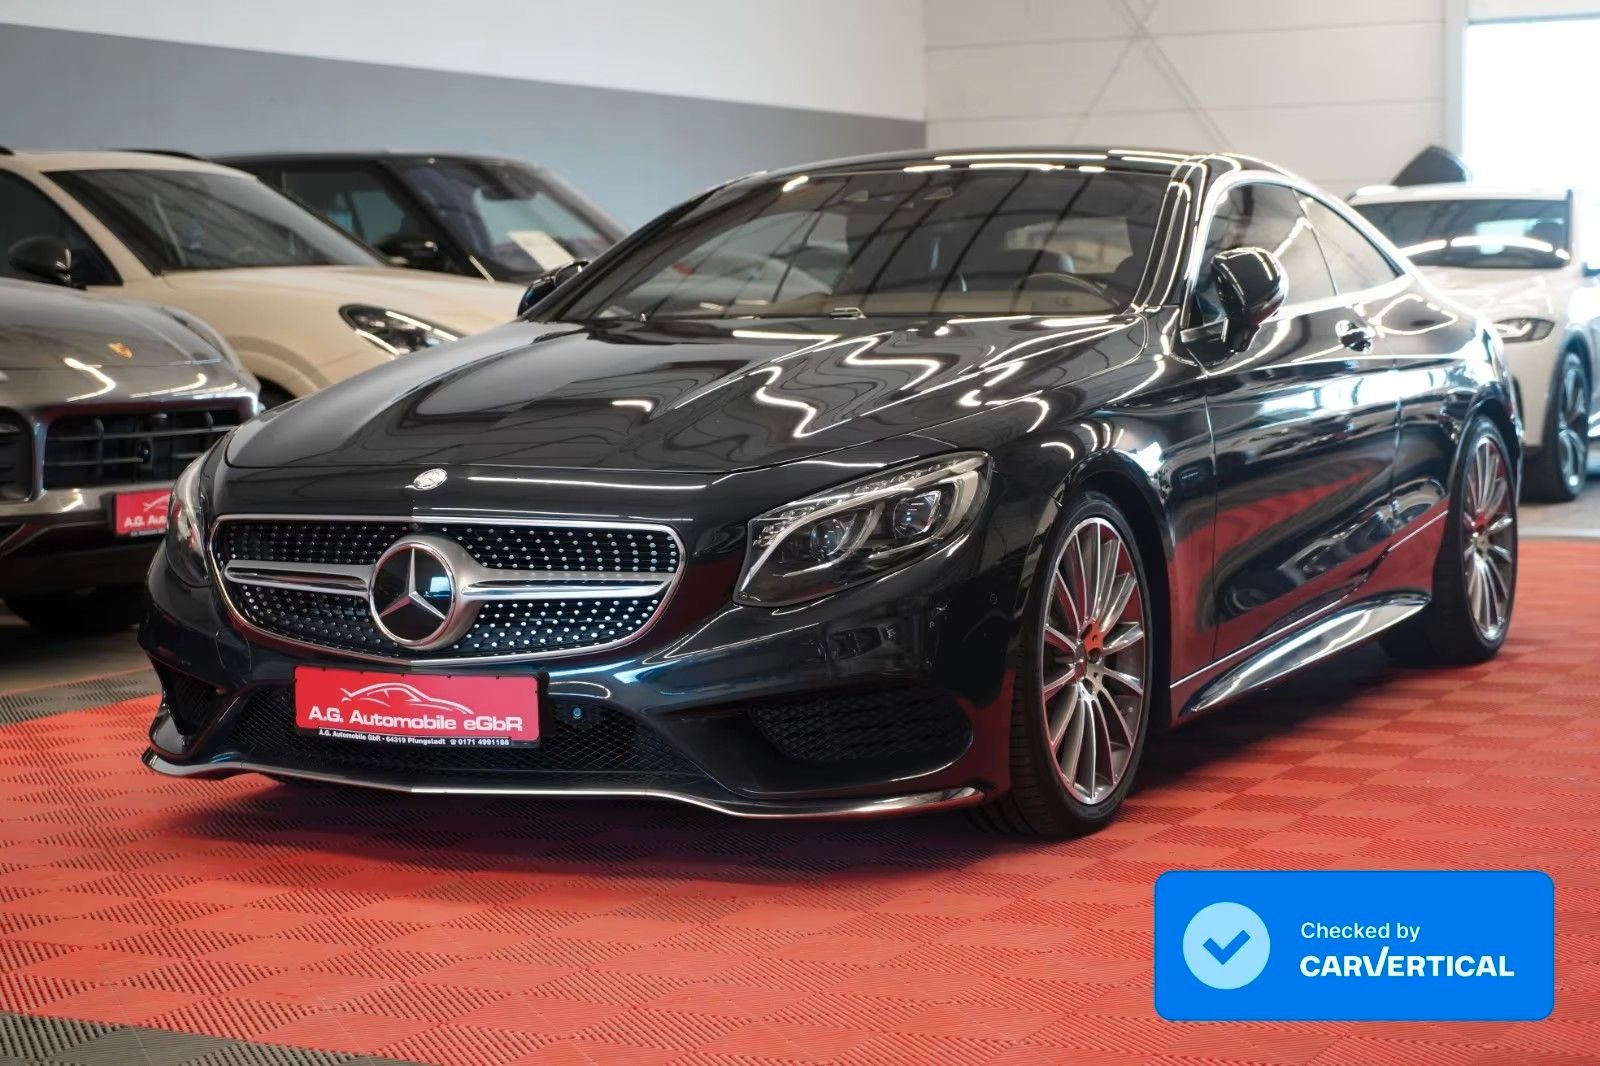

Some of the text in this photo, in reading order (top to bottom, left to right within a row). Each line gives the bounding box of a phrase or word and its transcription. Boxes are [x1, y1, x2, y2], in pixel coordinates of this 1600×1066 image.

[308, 705, 523, 732] A.G. Automobile eGbR
[332, 730, 366, 740] Automobile
[367, 734, 381, 742] GbR
